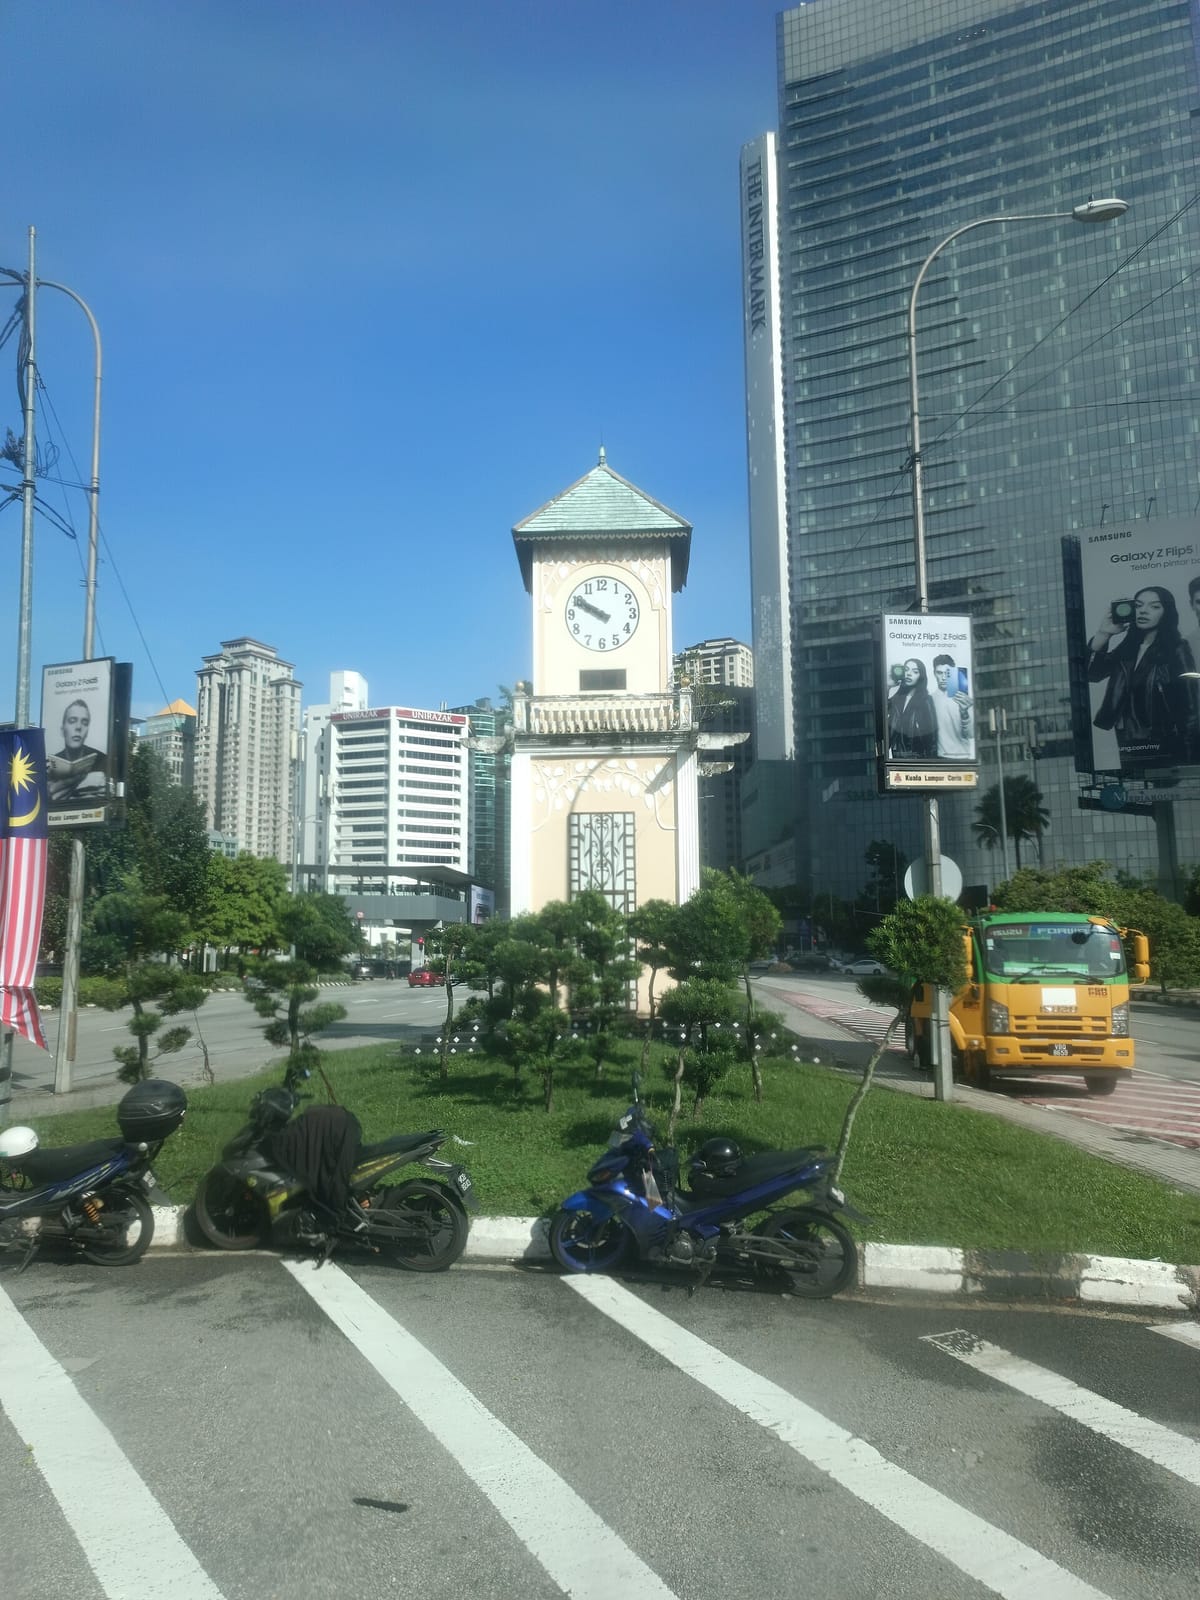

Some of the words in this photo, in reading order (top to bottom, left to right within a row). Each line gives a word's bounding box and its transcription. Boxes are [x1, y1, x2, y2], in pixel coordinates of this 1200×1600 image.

[747, 156, 763, 201] THE
[748, 201, 766, 335] INTERMARK
[1088, 531, 1132, 543] SAMSUNG
[1110, 551, 1155, 563] Galaxy
[1157, 548, 1164, 558] Z
[1165, 545, 1194, 558] Flip5
[1131, 561, 1162, 571] Telefon
[1163, 559, 1189, 568] pintar
[584, 583, 592, 594] 11
[597, 579, 607, 591] 12
[614, 582, 619, 594] 1
[624, 593, 632, 605] 2
[568, 609, 575, 621] 9
[629, 607, 637, 619] 3
[573, 623, 580, 635] 8
[623, 622, 631, 634] 4
[584, 634, 592, 646] 7
[612, 634, 620, 646] 5
[889, 632, 917, 641] Galaxy
[598, 637, 606, 649] 6
[412, 710, 453, 722] UNIRAZAK
[992, 928, 1022, 936] ISUZU
